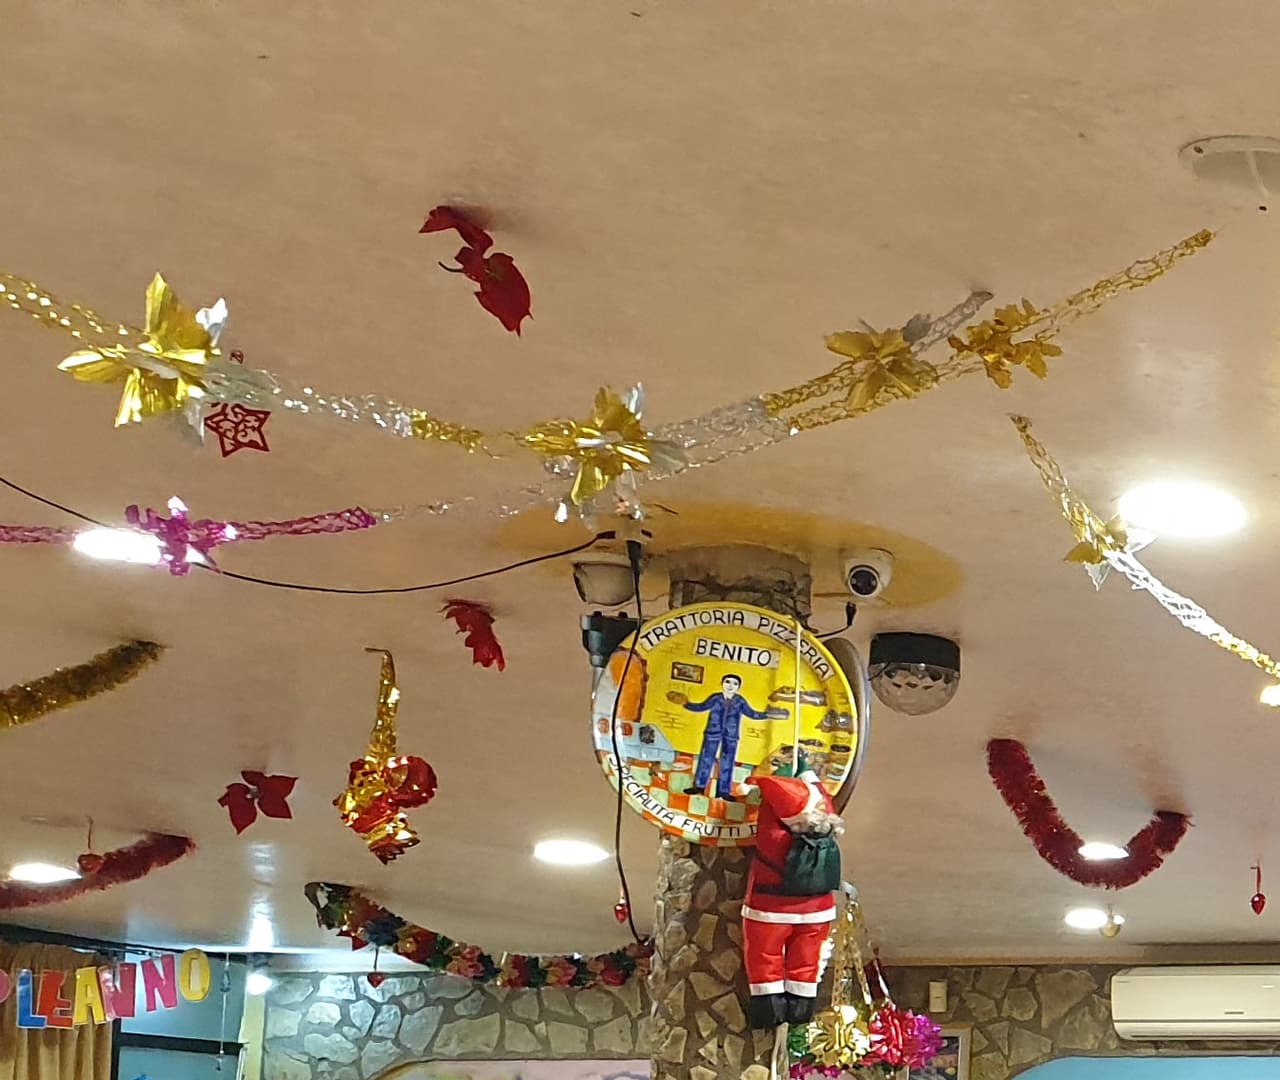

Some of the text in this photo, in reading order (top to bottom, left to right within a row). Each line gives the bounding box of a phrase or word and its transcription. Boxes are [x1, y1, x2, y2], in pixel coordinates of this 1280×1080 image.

[639, 609, 830, 679] TRATTORIA PIZZERIA
[696, 637, 772, 667] BENITO
[681, 818, 740, 837] FRUTTI
